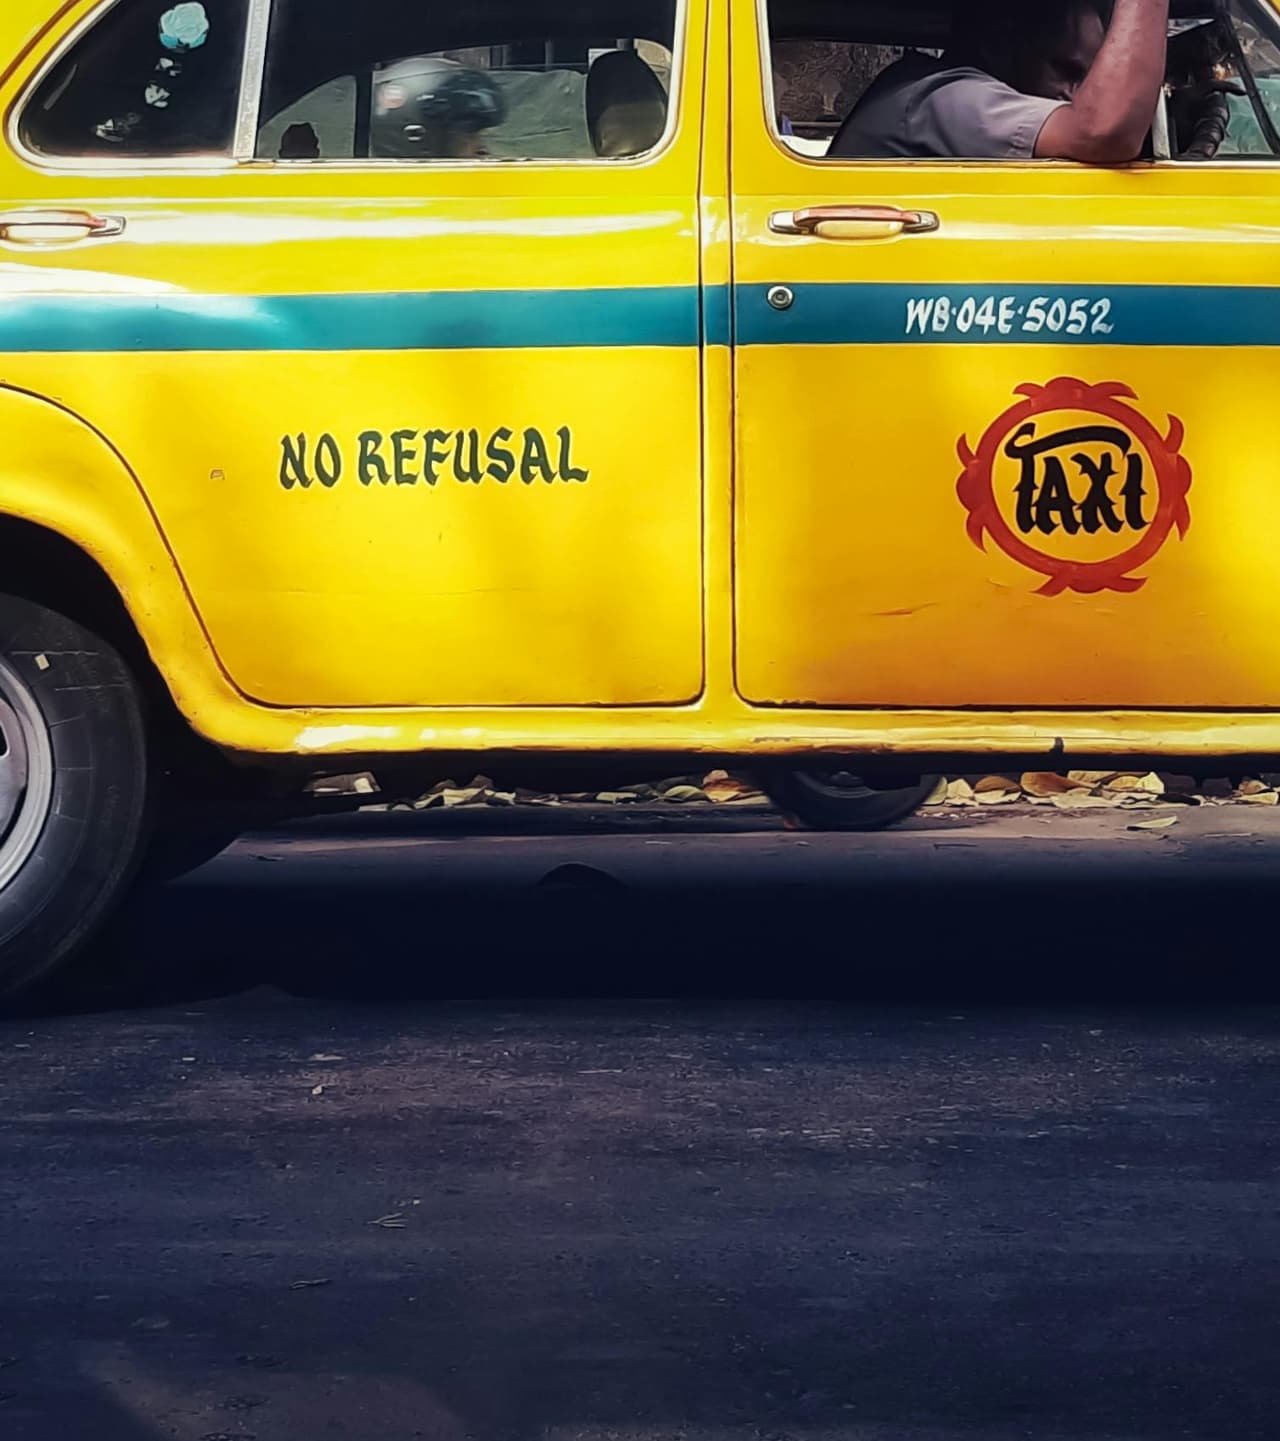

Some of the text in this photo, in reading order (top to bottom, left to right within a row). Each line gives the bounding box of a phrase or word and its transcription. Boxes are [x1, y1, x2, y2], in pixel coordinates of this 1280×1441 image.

[279, 426, 589, 490] NO REFUSAL
[1004, 422, 1151, 536] TAXI
